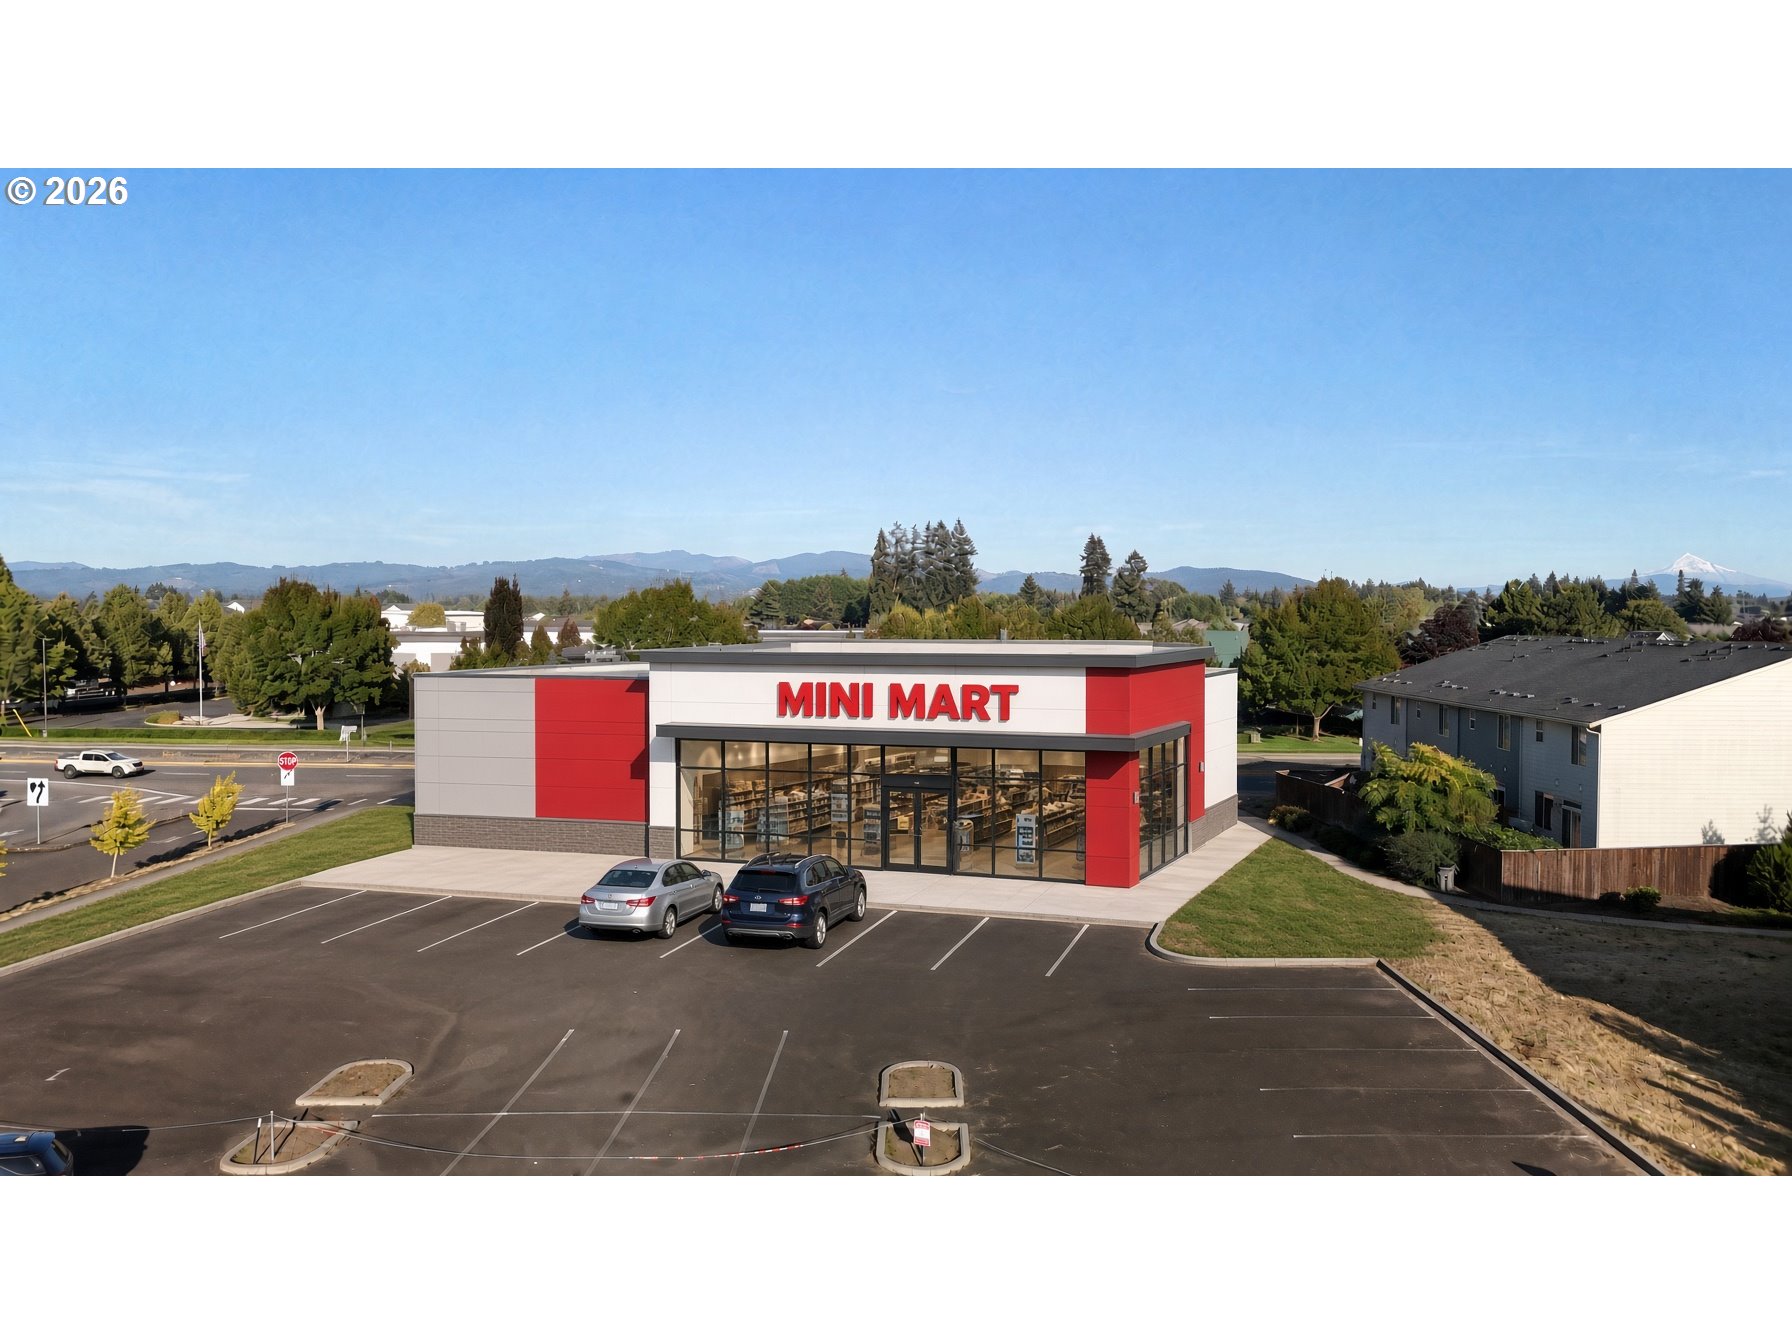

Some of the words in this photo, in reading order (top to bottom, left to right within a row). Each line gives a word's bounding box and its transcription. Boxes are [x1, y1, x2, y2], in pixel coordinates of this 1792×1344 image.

[777, 682, 873, 718] MINI
[888, 683, 1019, 721] MART
[280, 757, 297, 766] STOP
